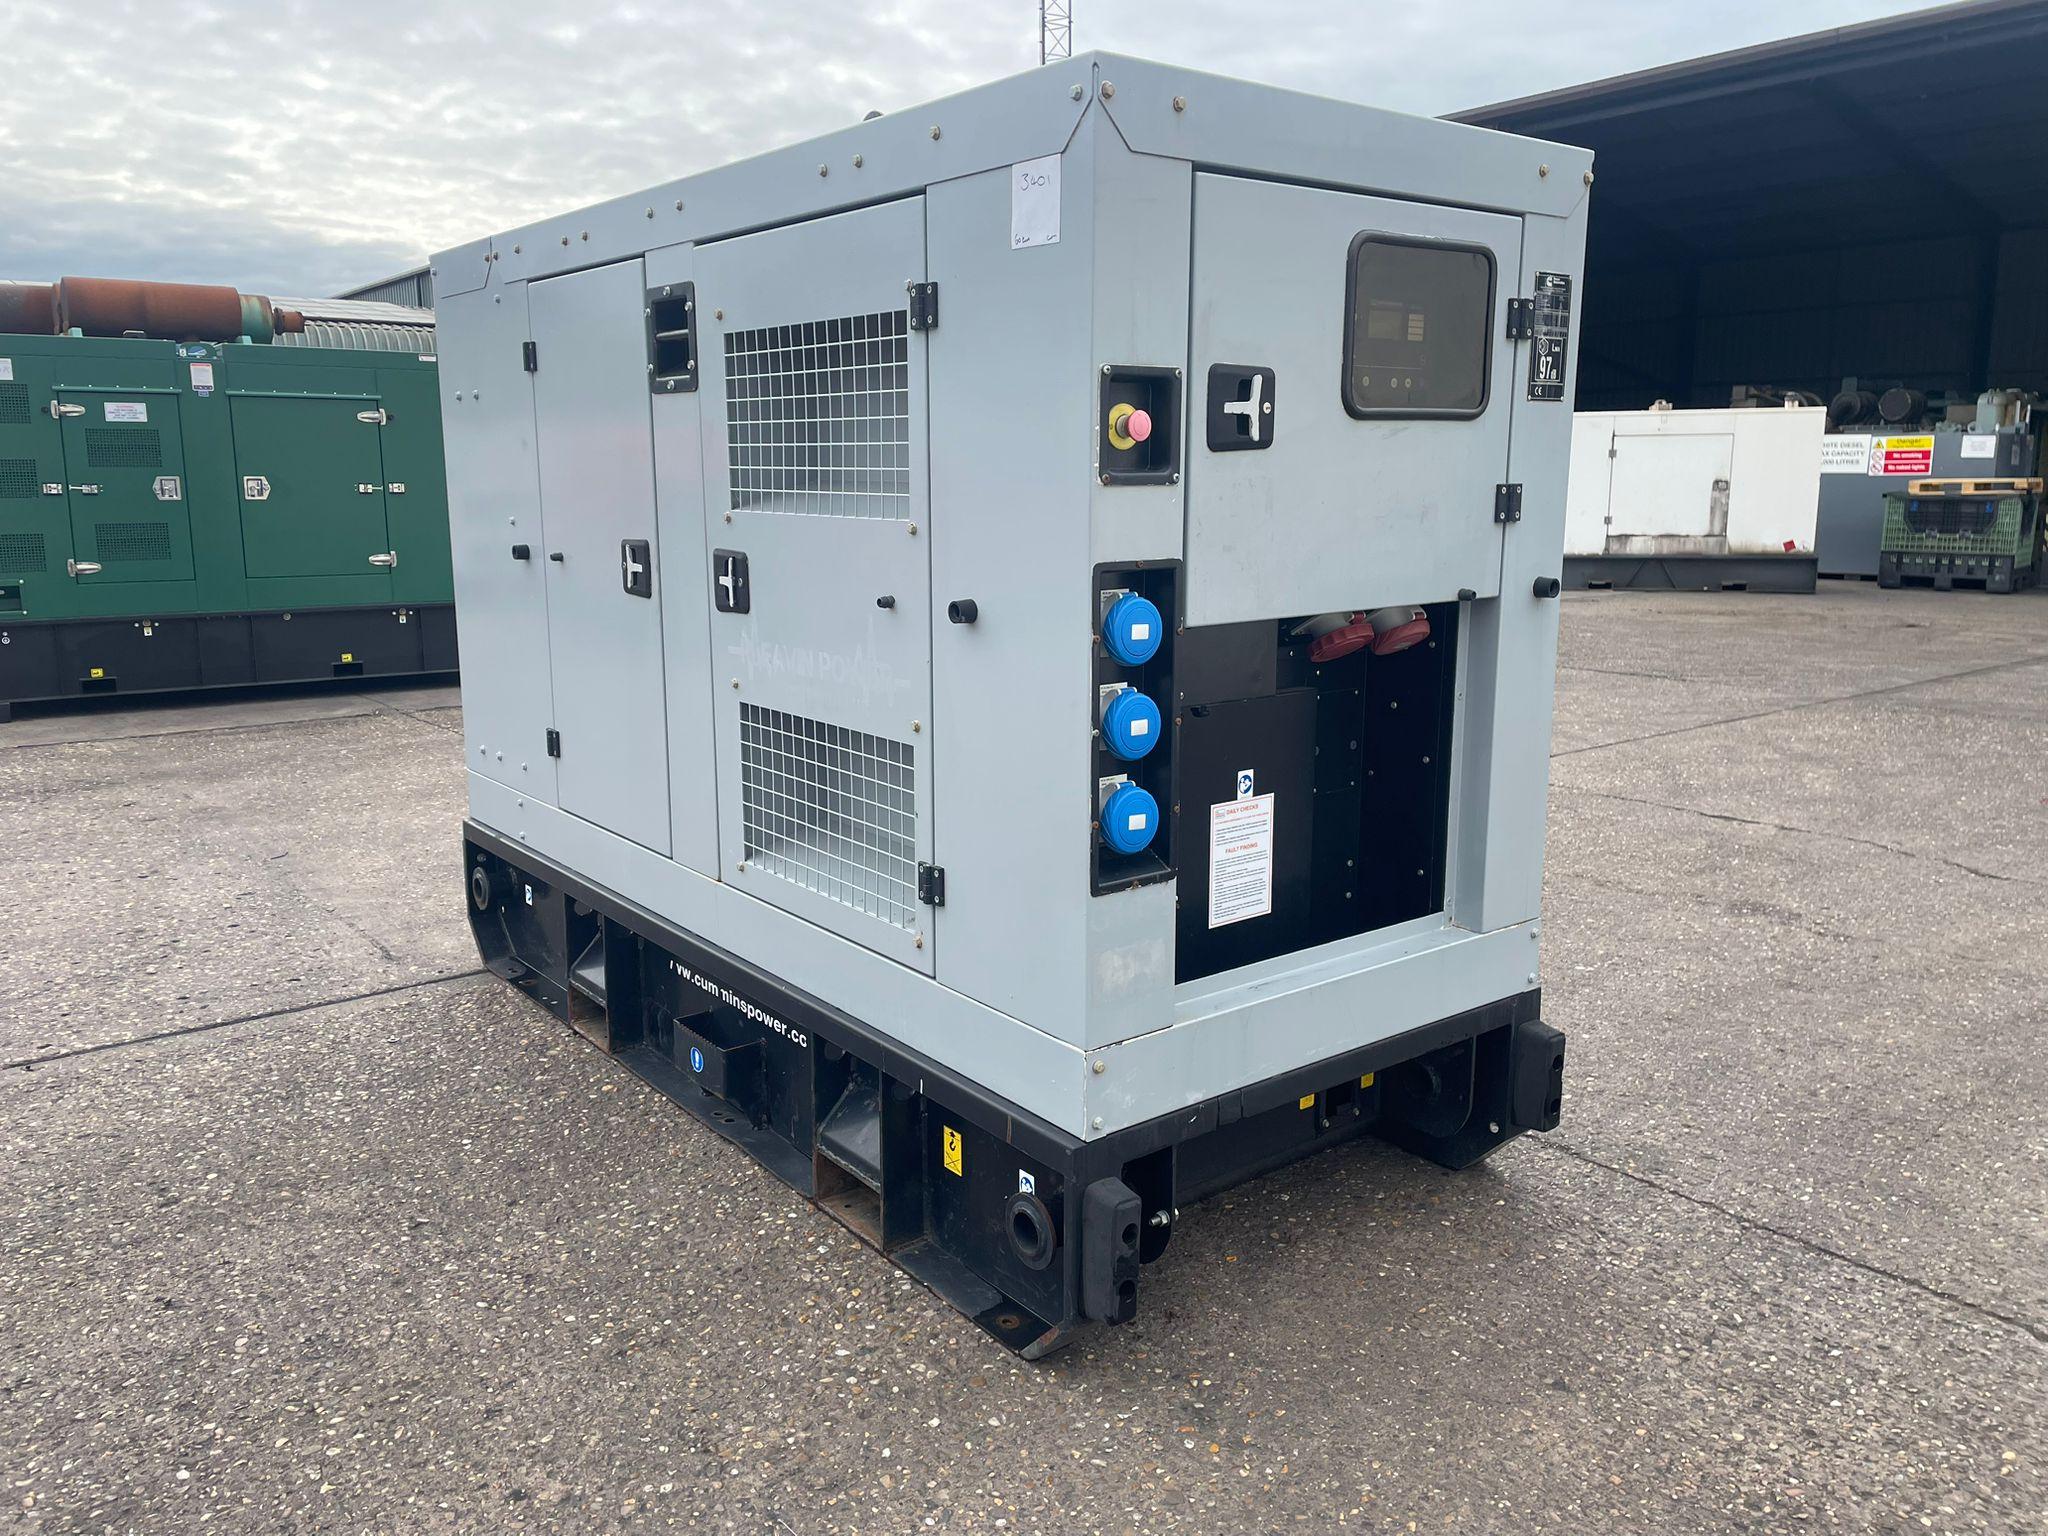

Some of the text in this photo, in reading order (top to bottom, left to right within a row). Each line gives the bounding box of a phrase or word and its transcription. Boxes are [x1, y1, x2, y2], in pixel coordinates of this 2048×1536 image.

[1539, 356, 1552, 379] 97
[1534, 386, 1543, 396] CE
[1831, 449, 1865, 457] CAPACITY
